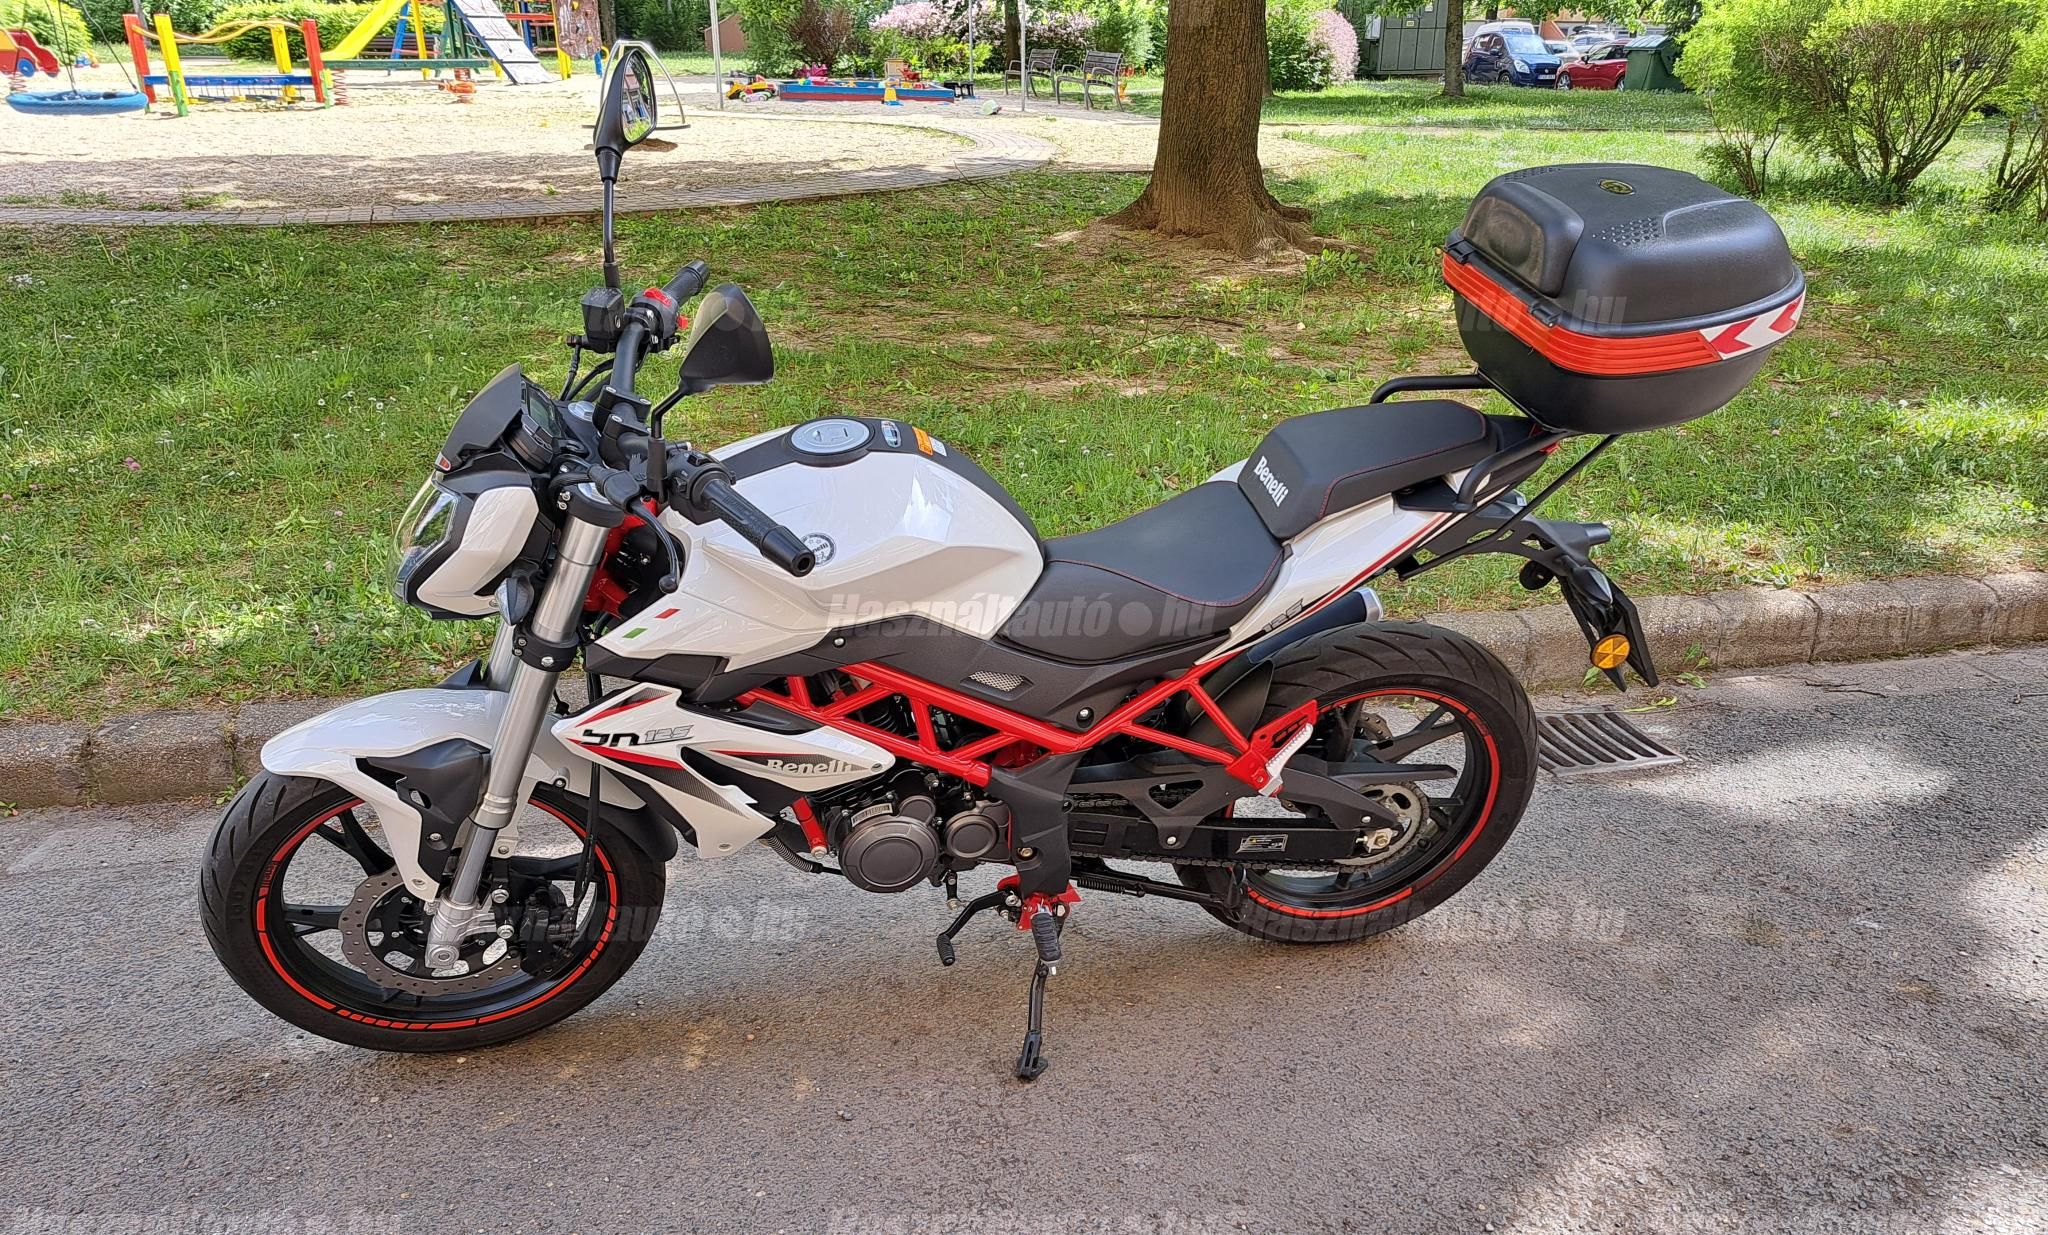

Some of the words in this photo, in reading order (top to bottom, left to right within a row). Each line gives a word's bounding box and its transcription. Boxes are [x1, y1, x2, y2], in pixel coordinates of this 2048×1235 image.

[1254, 455, 1289, 507] Benelli
[644, 724, 695, 742] 125
[767, 759, 852, 776] Benelli
